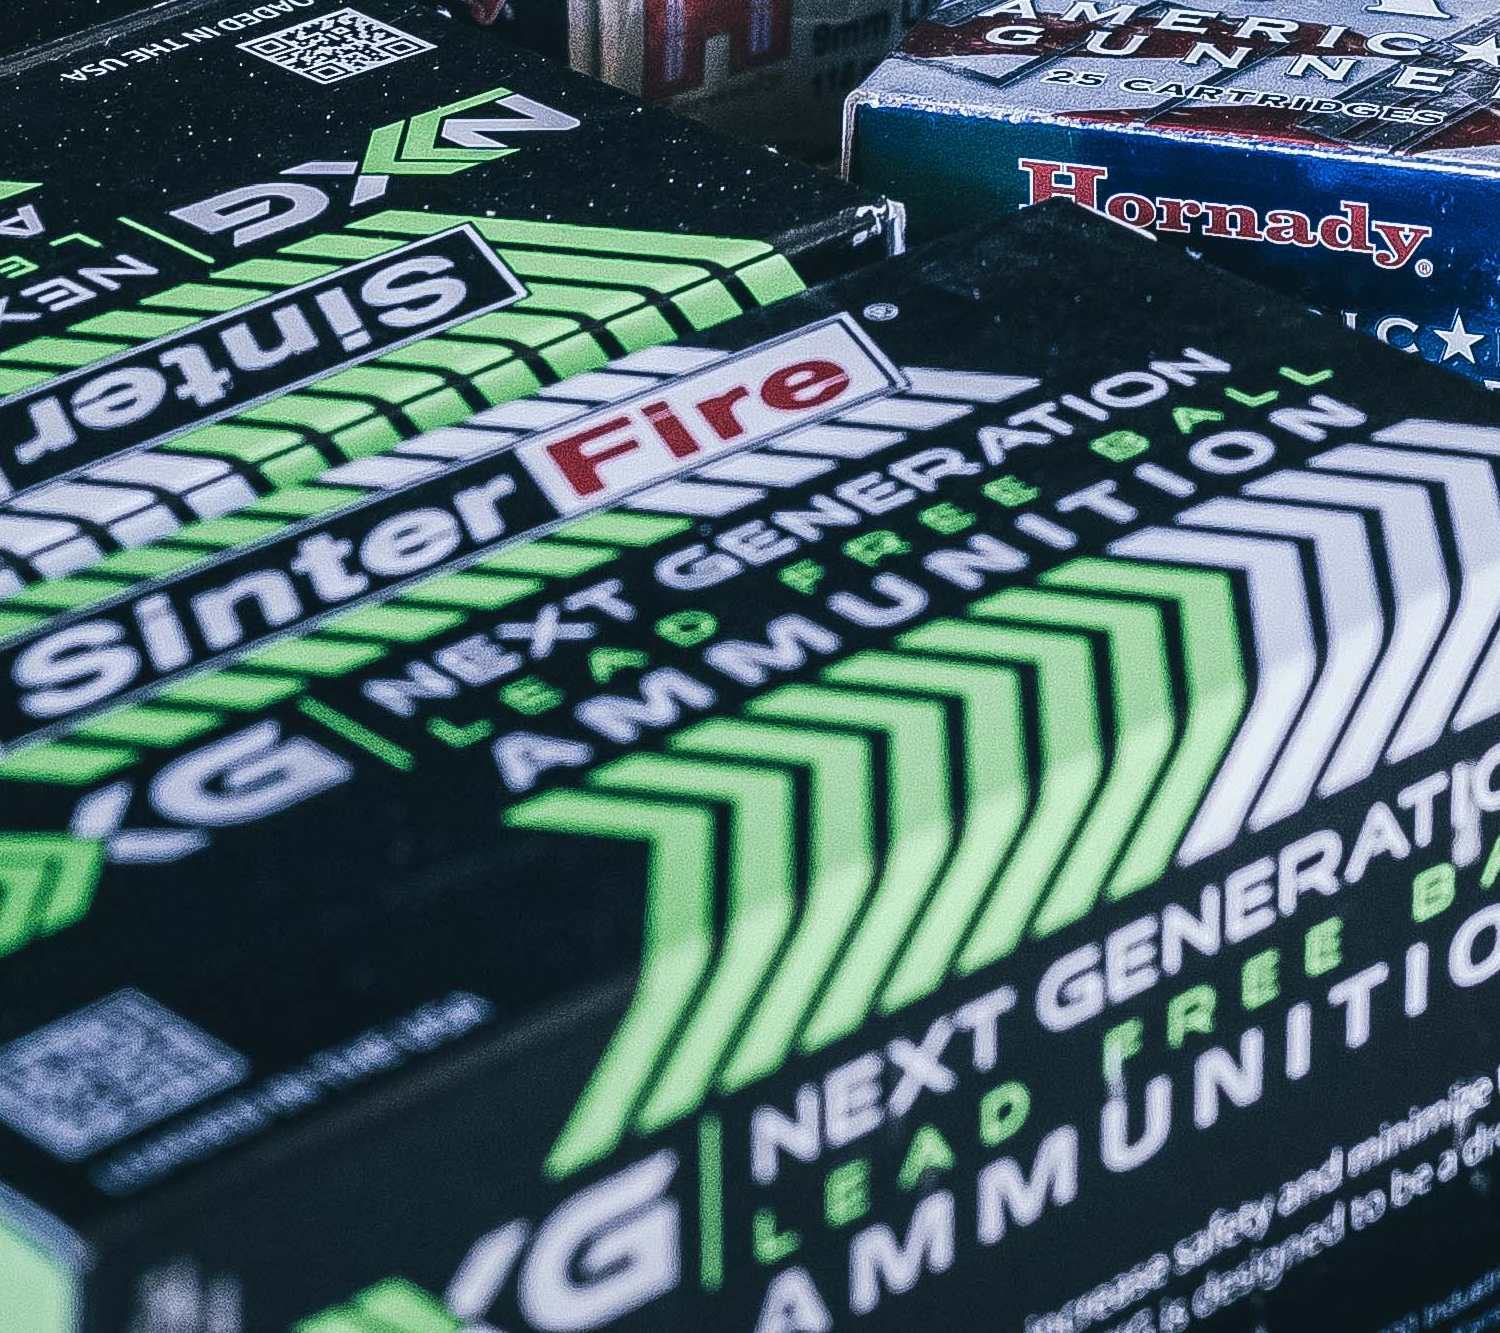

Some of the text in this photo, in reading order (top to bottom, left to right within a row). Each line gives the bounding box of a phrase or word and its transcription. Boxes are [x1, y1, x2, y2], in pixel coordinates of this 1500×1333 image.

[61, 58, 129, 82] USA
[121, 38, 189, 63] THE
[182, 28, 222, 44] IN
[1043, 67, 1445, 127] 25 CARTRIDGES
[169, 87, 581, 247] NXG
[8, 358, 853, 720] SinterFire
[363, 347, 1234, 717] NEXT GENERATION
[426, 362, 1335, 749] LEAD FREE BALL
[494, 393, 1368, 792] AMMUNITION
[751, 988, 1019, 1184] NEXT
[752, 1078, 1030, 1263] LEAD
[1103, 916, 1345, 1079] FREE
